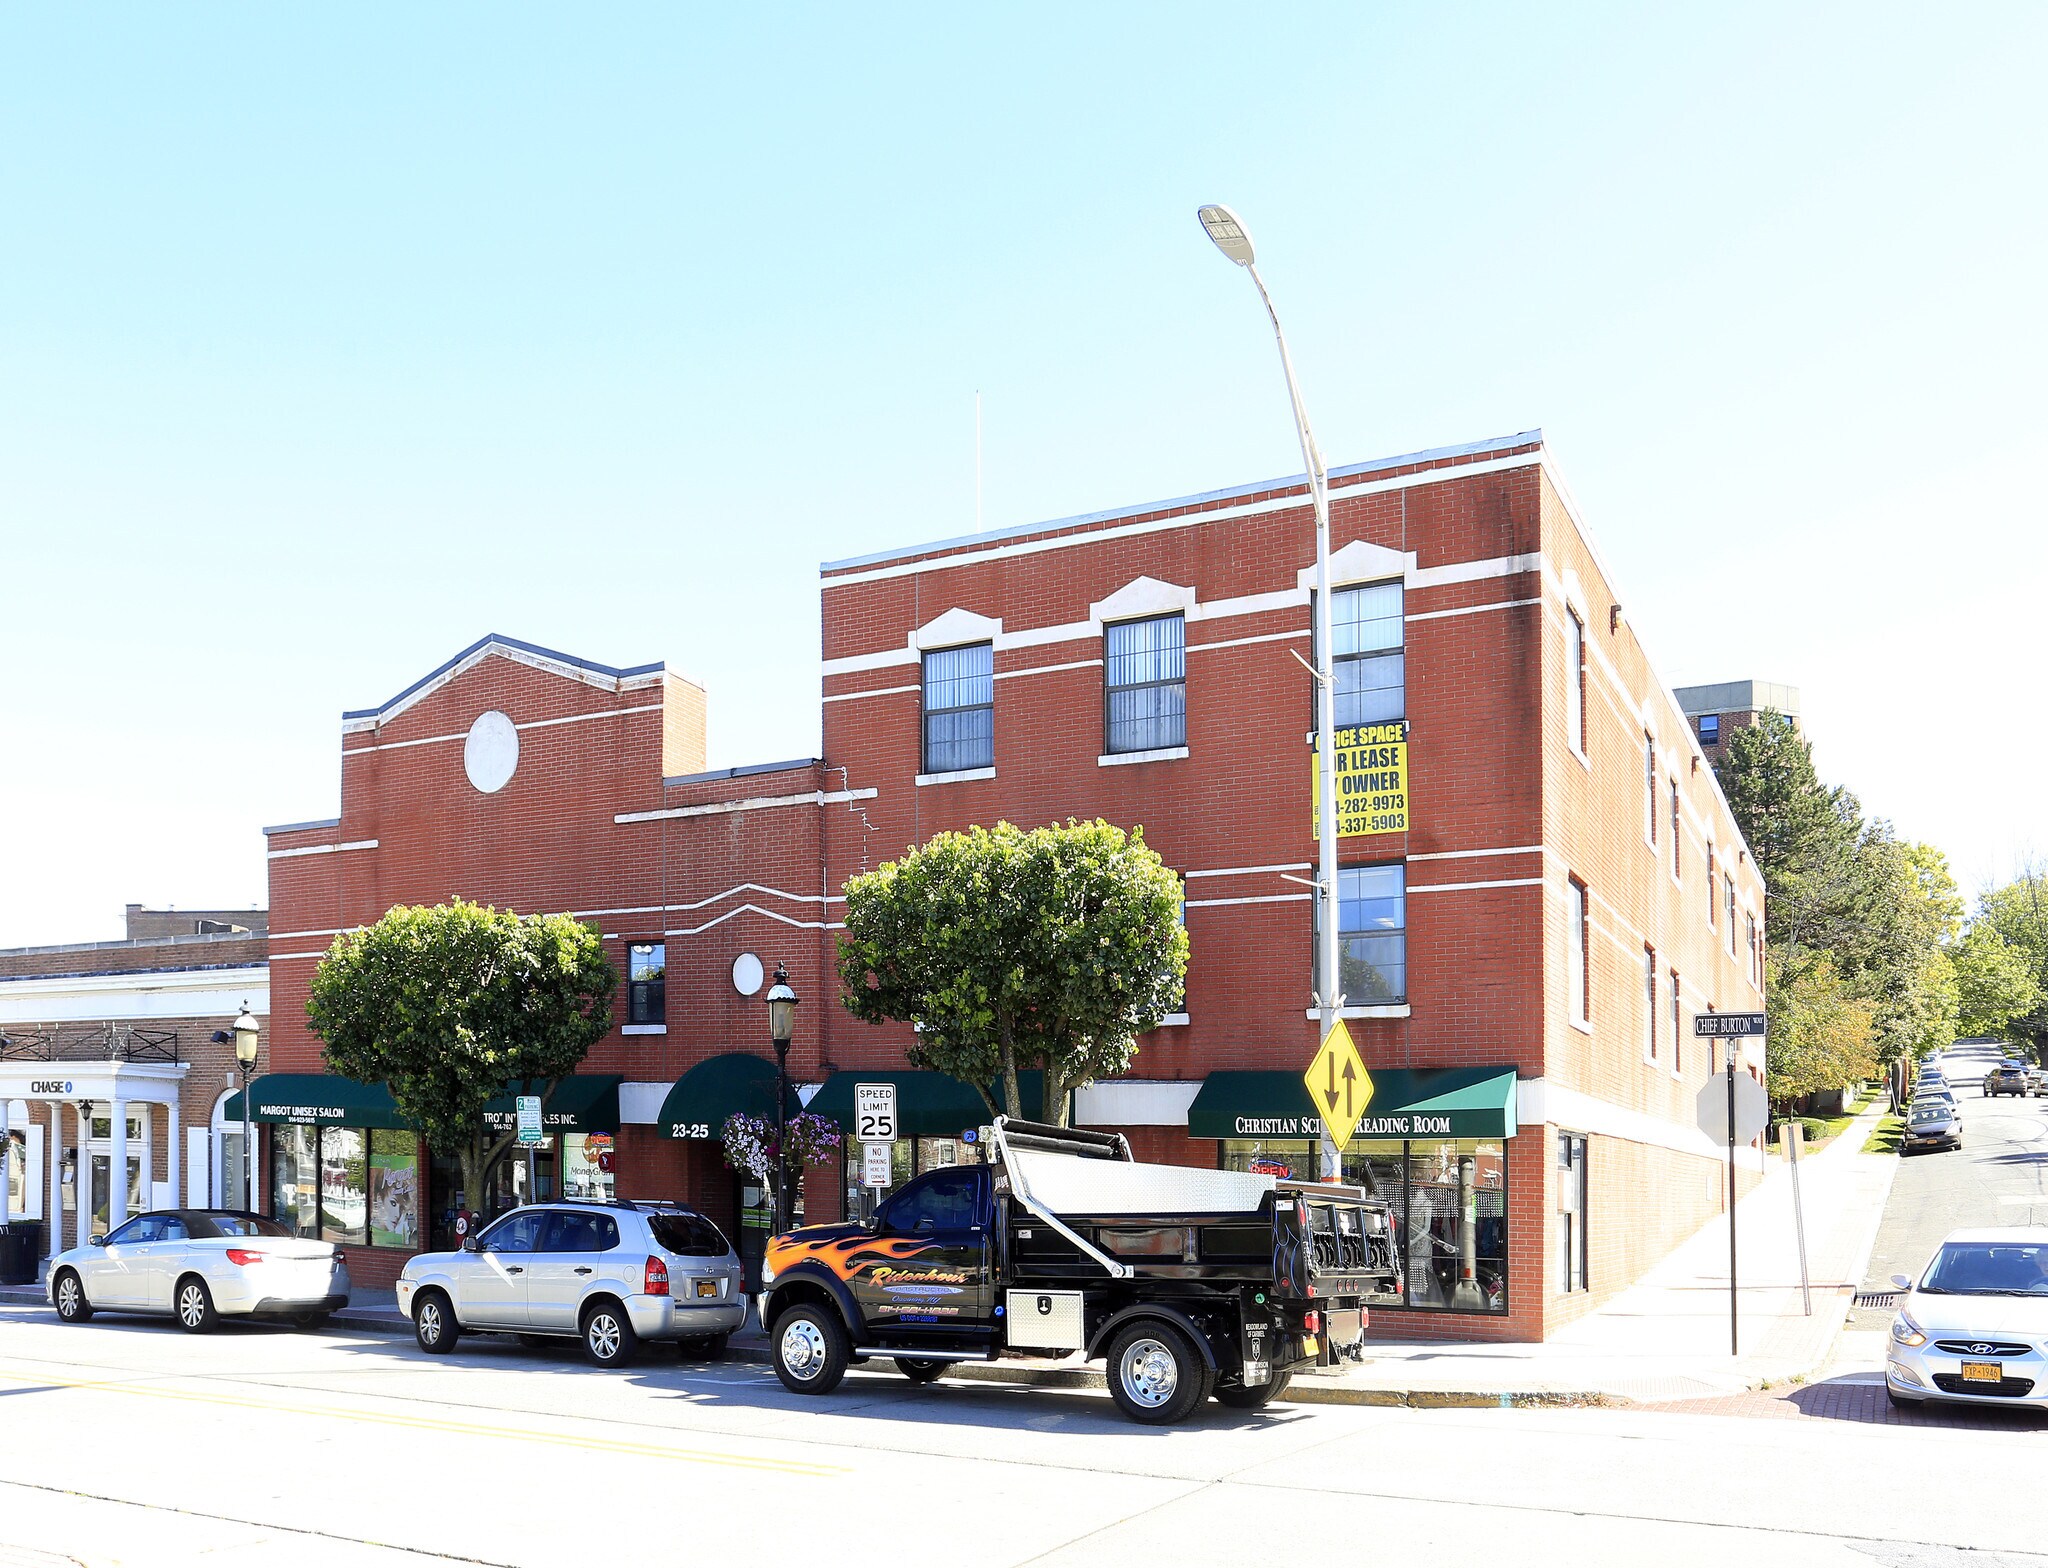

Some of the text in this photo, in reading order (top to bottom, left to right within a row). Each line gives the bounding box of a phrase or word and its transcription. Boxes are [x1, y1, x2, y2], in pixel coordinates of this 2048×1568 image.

[1359, 725, 1403, 745] SPACE
[1352, 747, 1399, 770] LEASE
[1342, 771, 1399, 795] OWNER
[1696, 1018, 1718, 1033] CHIEF
[1721, 1017, 1751, 1033] BURTON
[31, 1081, 64, 1093] CHASE
[860, 1089, 892, 1099] SPEED
[260, 1105, 345, 1118] MARGOT UNISEX SALON
[518, 1099, 524, 1110] 2
[863, 1102, 888, 1111] LIMIT
[561, 1114, 578, 1125] INC.
[861, 1115, 893, 1136] 25
[1236, 1116, 1298, 1134] CHRISTIAN
[1354, 1117, 1410, 1134] READING
[1413, 1116, 1451, 1134] ROOM
[672, 1123, 709, 1138] 23-25
[872, 1147, 882, 1156] NO
[1250, 1164, 1289, 1178] OPEN
